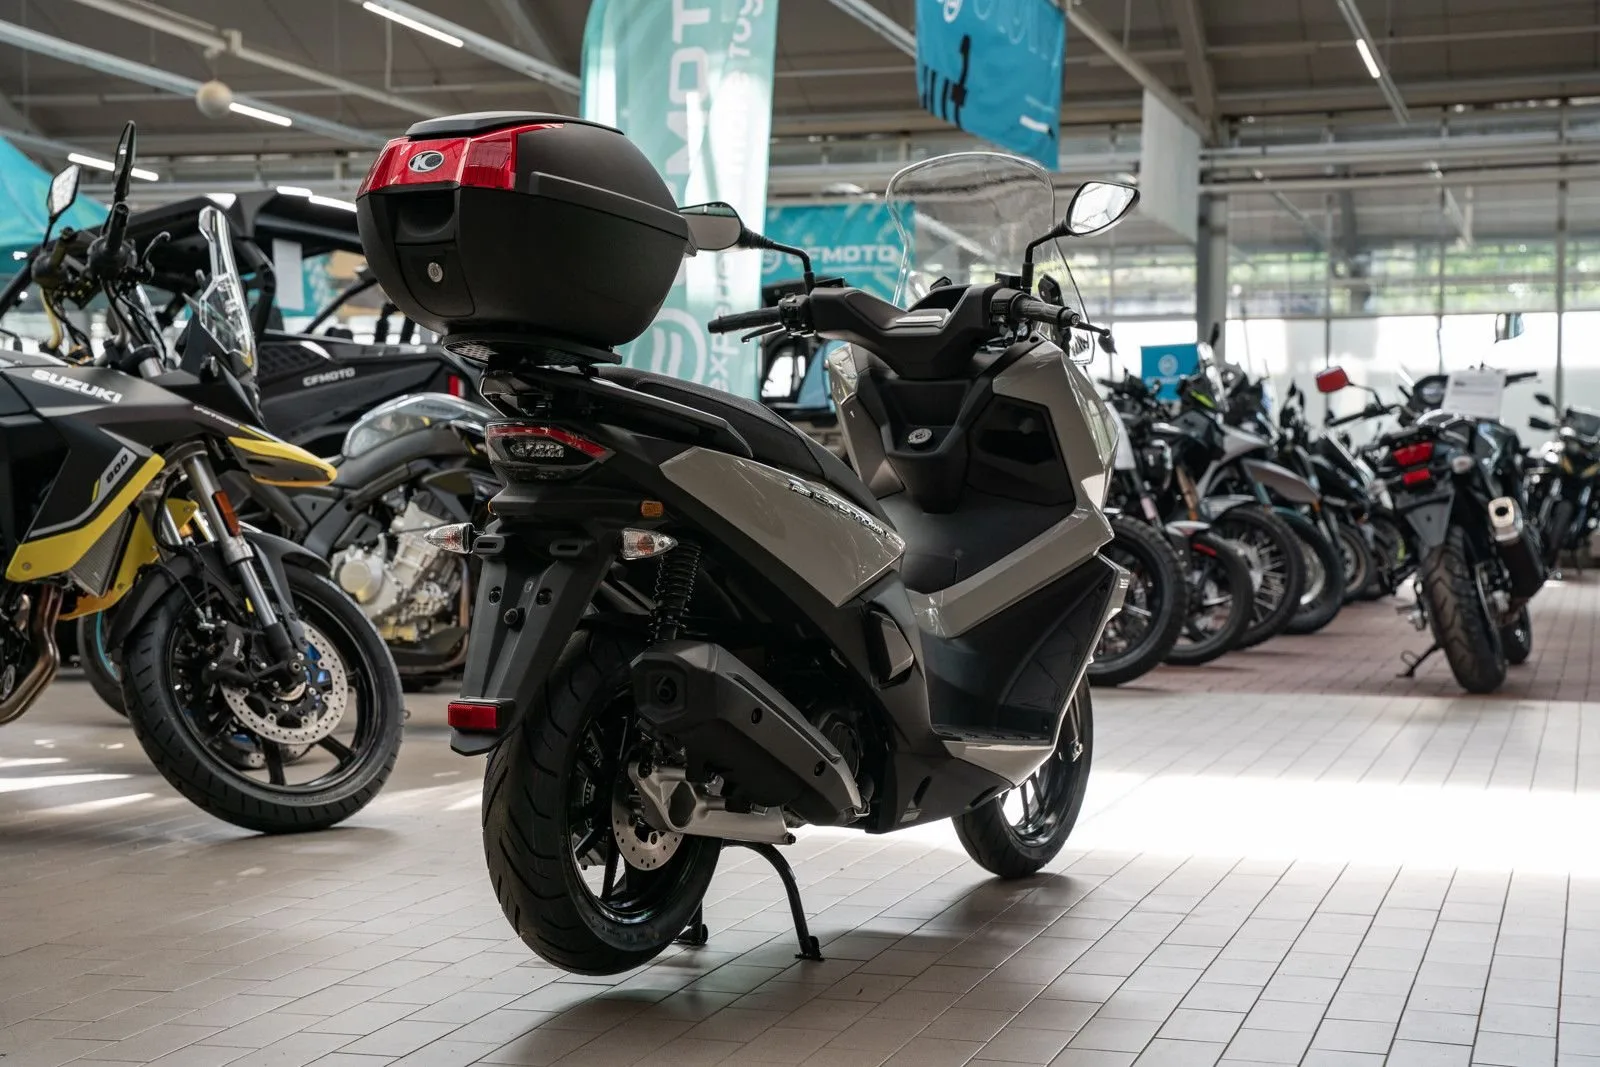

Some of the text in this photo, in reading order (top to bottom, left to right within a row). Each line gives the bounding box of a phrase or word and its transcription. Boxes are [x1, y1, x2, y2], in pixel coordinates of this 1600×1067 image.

[31, 369, 124, 404] SUZUKI
[303, 367, 356, 387] CFMOTO
[106, 454, 129, 484] 800
